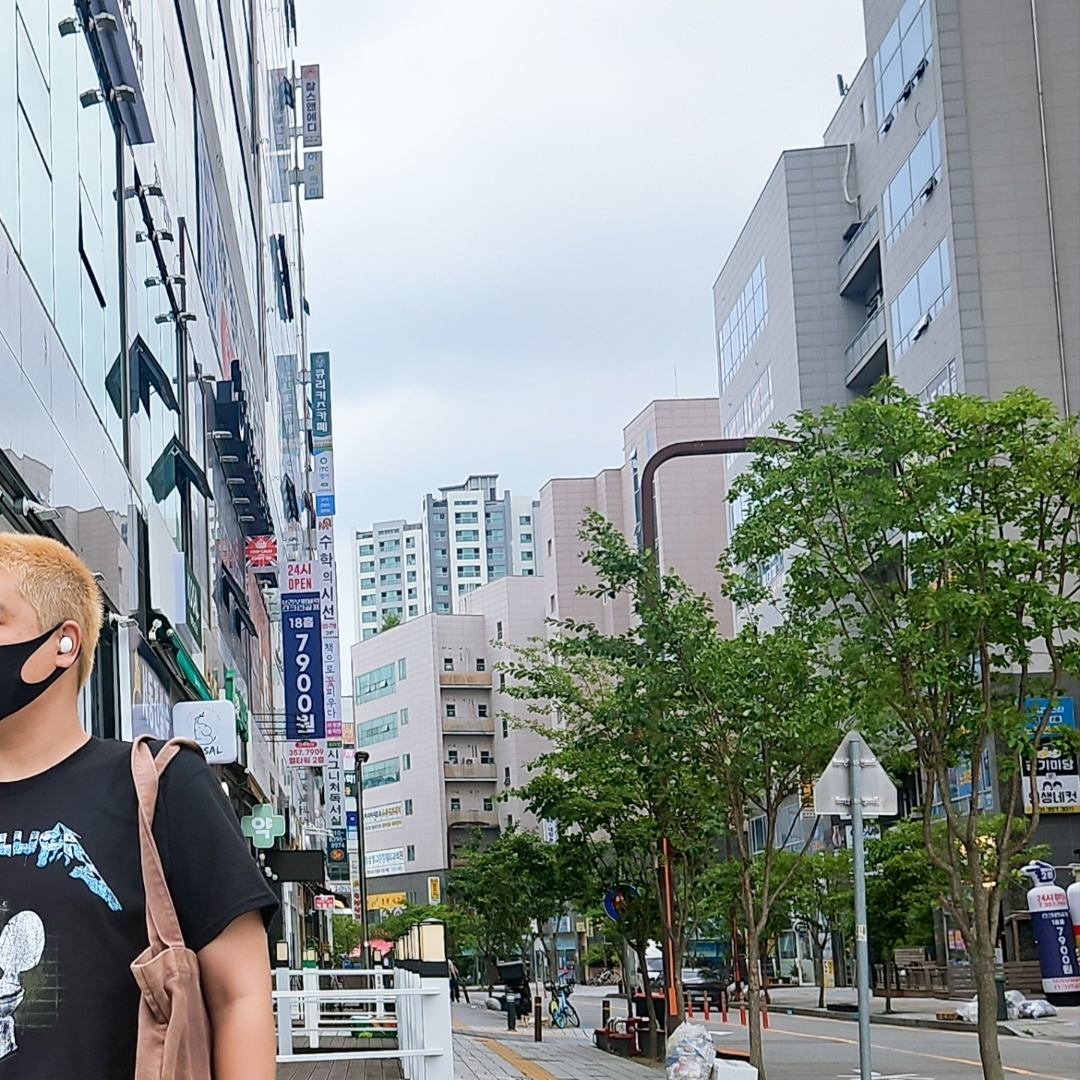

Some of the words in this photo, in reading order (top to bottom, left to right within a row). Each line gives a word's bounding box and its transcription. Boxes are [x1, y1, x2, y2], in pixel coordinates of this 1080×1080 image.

[287, 563, 312, 576] 24시
[288, 577, 312, 590] OPEN
[251, 816, 272, 839] 약
[1056, 927, 1074, 975] 7900원
